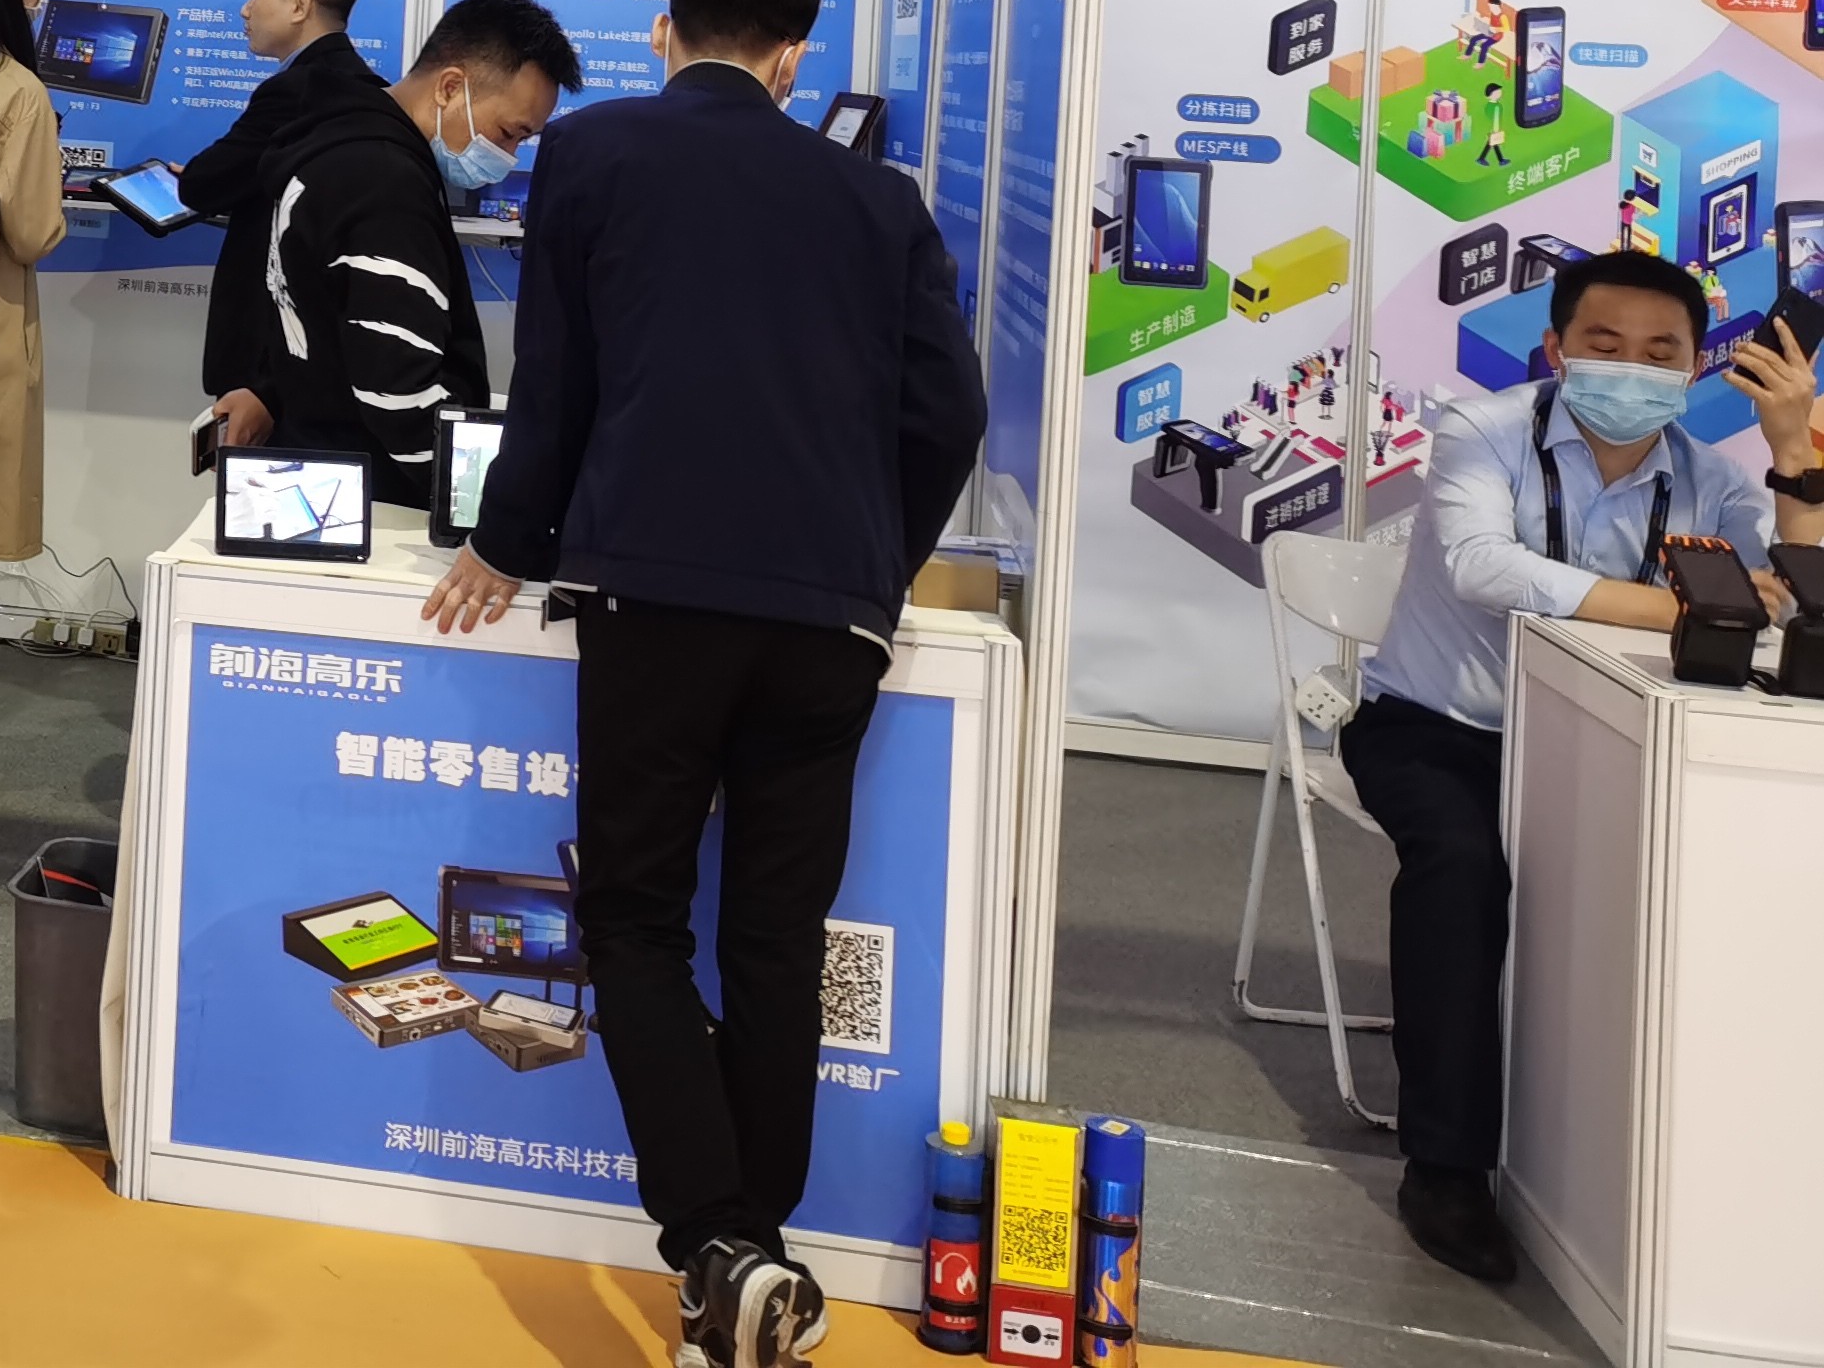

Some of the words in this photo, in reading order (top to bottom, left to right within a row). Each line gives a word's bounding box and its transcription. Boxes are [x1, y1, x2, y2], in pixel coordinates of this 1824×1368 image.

[176, 8, 233, 23] 产品特点：
[1578, 47, 1639, 63] 快递扫描
[1185, 99, 1252, 119] 分拣扫描
[1183, 140, 1249, 157] MES产线
[1704, 147, 1759, 179] SHOPPING
[1506, 145, 1581, 196] 终端客户
[1460, 240, 1498, 268] 智慧
[1460, 265, 1497, 295] 门店
[1129, 304, 1197, 353] 生产制造
[1137, 379, 1171, 407] 智慧
[1136, 405, 1171, 432] 服装
[209, 643, 403, 693] 前海高乐
[335, 731, 580, 798] 智能零售设
[384, 1121, 639, 1183] 深圳前海高乐科技有
